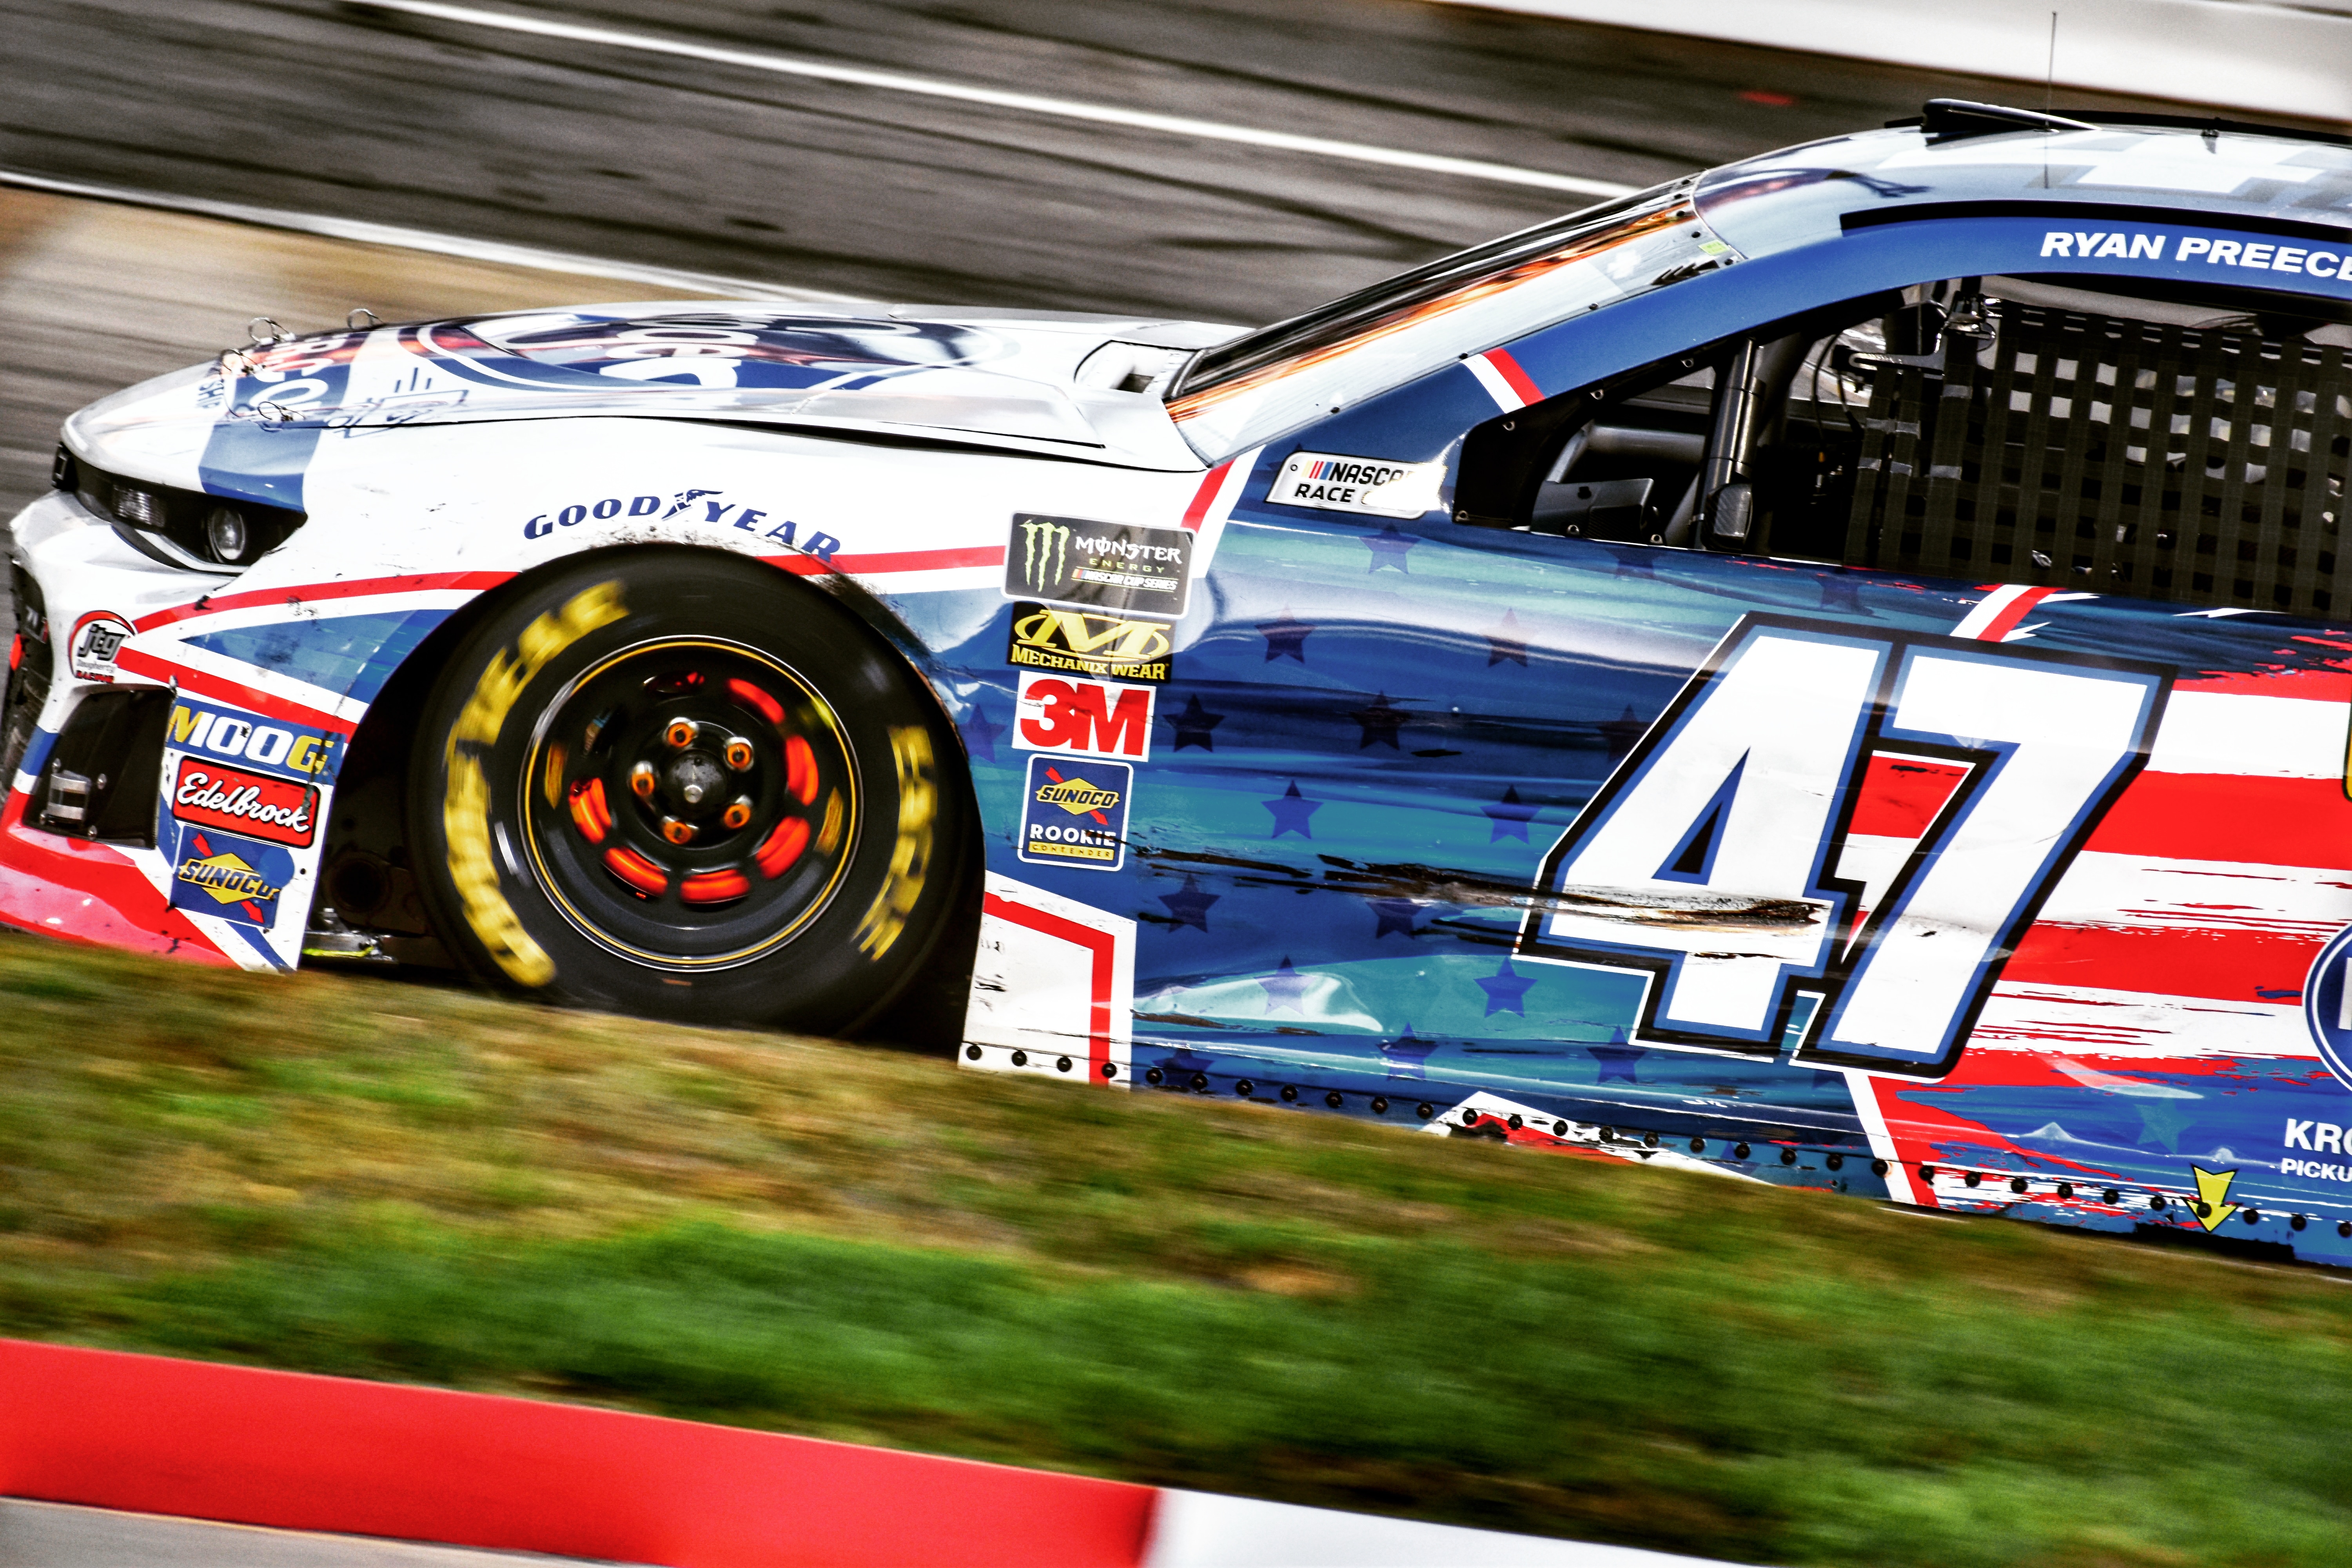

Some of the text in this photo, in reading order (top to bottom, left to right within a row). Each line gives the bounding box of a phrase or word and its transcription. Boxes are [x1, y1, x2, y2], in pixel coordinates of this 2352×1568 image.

[2040, 232, 2166, 260] RYAN
[1329, 462, 1415, 486] NASCA
[1295, 484, 1355, 503] RACE
[524, 492, 841, 563] GOODYEAR
[1075, 536, 1182, 564] MONSTER
[1089, 558, 1165, 573] ENERGY
[1084, 571, 1178, 590] NASCAR CUP SERIES
[1011, 644, 1166, 681] MECHANIX WEAR
[1020, 679, 1150, 757] 3M
[166, 705, 334, 775] MOOG
[176, 772, 310, 833] Edelbrock
[1040, 787, 1116, 807] SUNOCO
[1029, 824, 1116, 847] ROOKIE
[1535, 623, 2164, 1068] 47
[1032, 843, 1110, 858] CONTENDER
